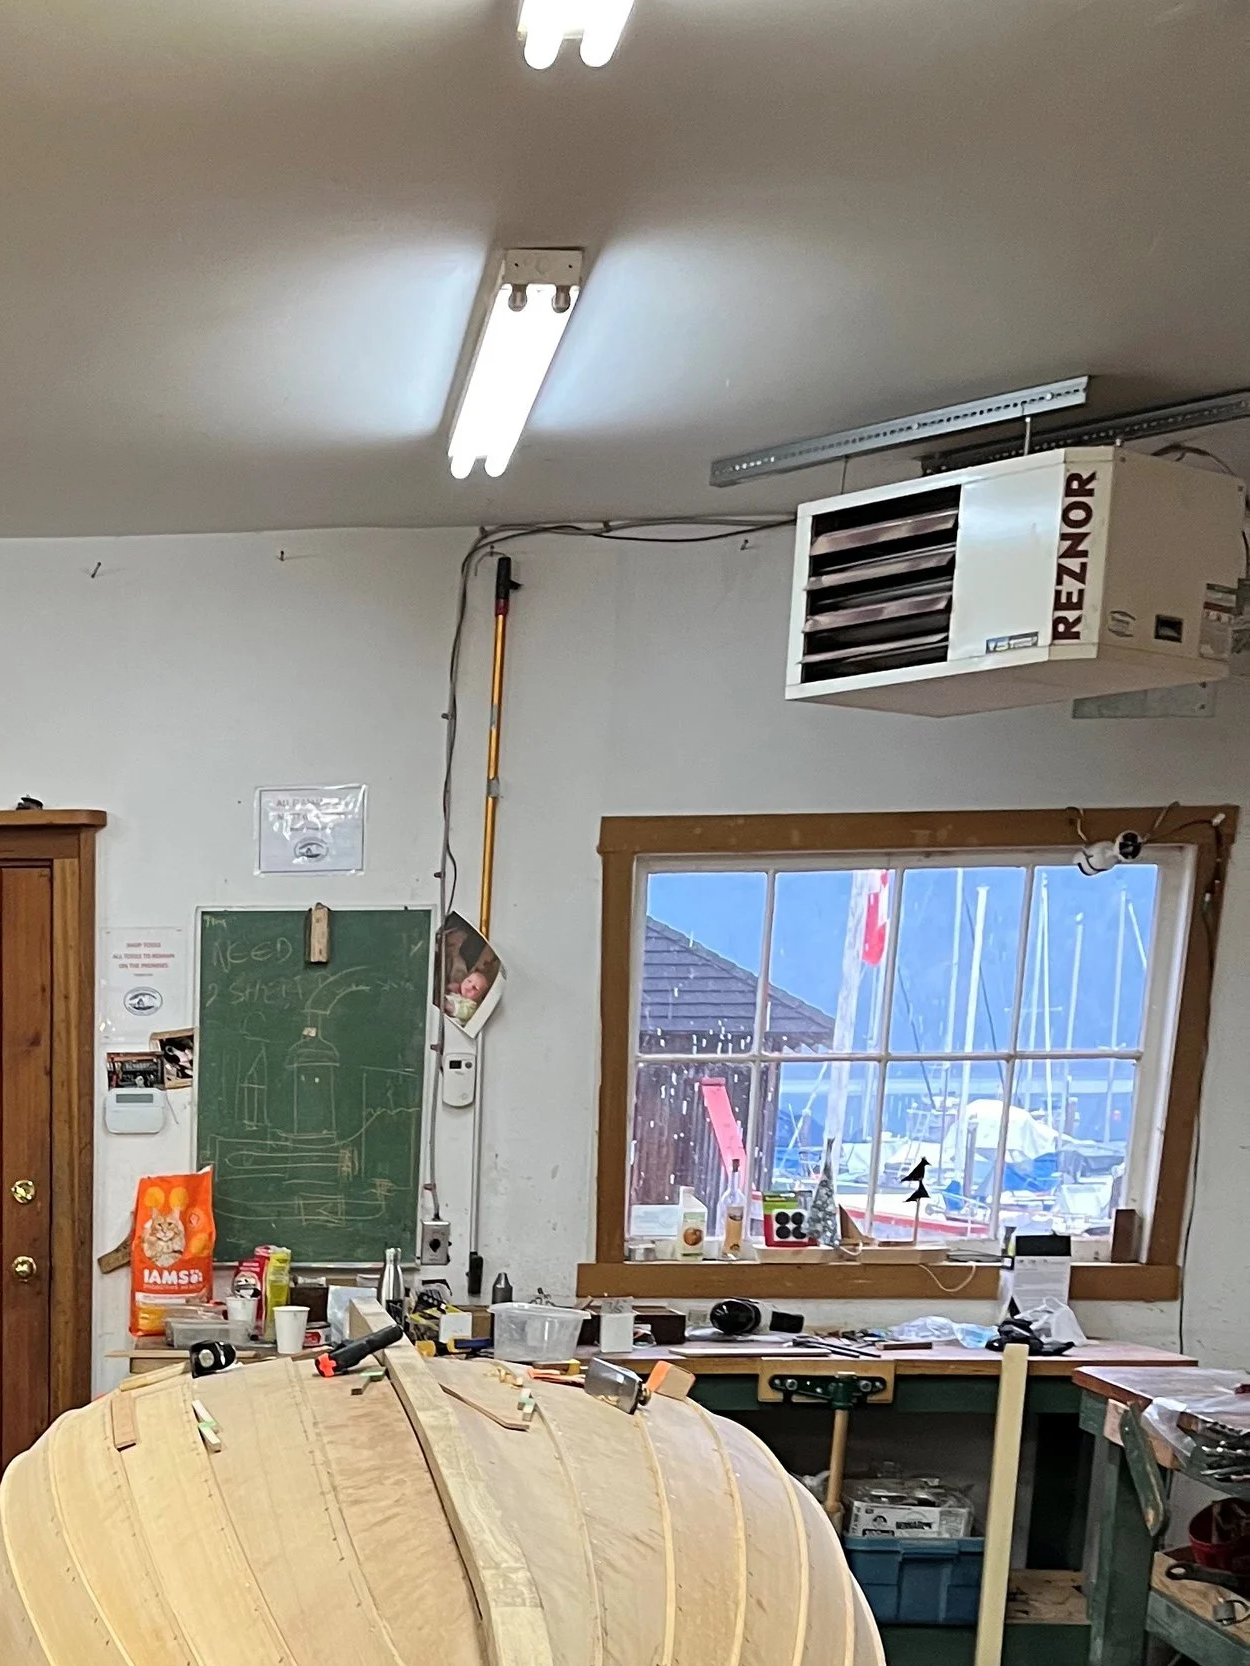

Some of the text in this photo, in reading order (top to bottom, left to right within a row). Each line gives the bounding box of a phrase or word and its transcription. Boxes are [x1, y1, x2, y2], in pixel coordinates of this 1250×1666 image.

[1052, 471, 1097, 640] REZNOR
[213, 937, 293, 973] NEED
[143, 1268, 190, 1285] IAMS
